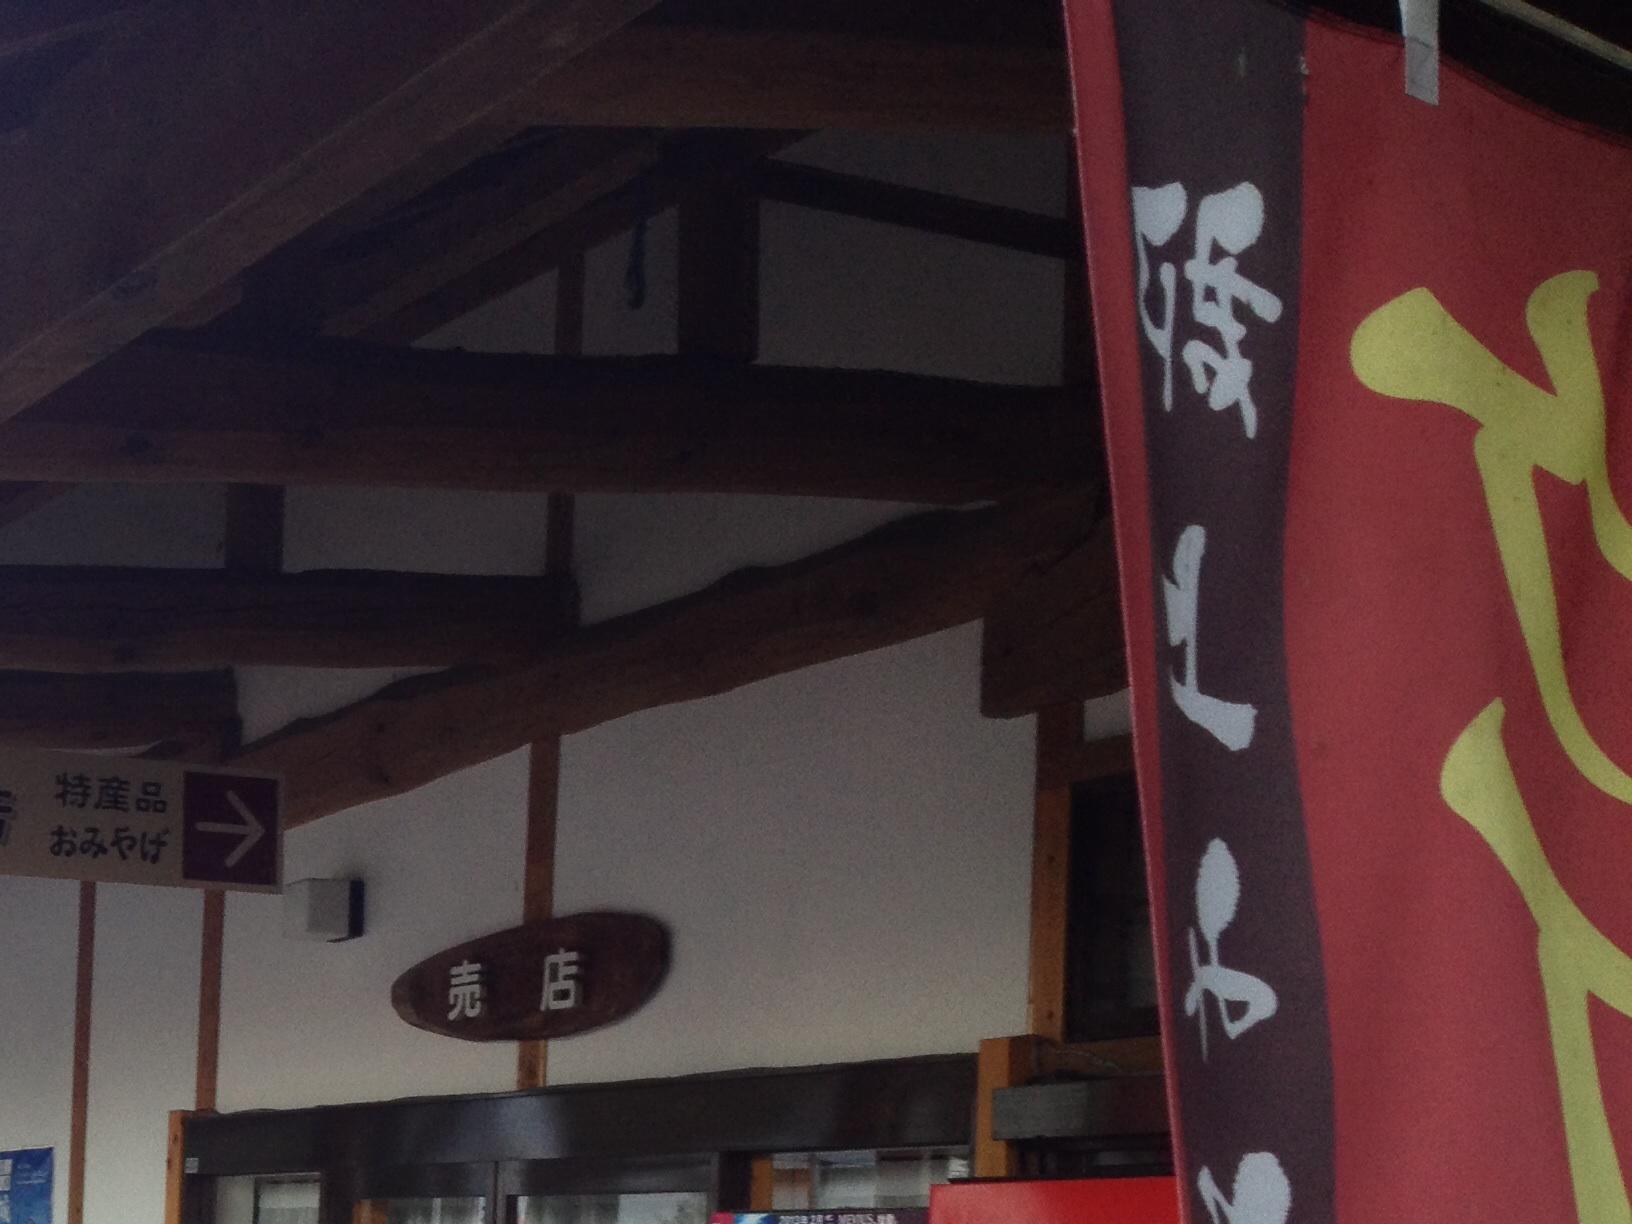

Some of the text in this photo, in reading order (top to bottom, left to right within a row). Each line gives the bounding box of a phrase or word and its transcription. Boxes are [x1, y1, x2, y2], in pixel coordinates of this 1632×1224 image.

[54, 771, 168, 814] 特産品
[49, 824, 169, 864] おみやげ
[447, 948, 580, 1022] 売店
